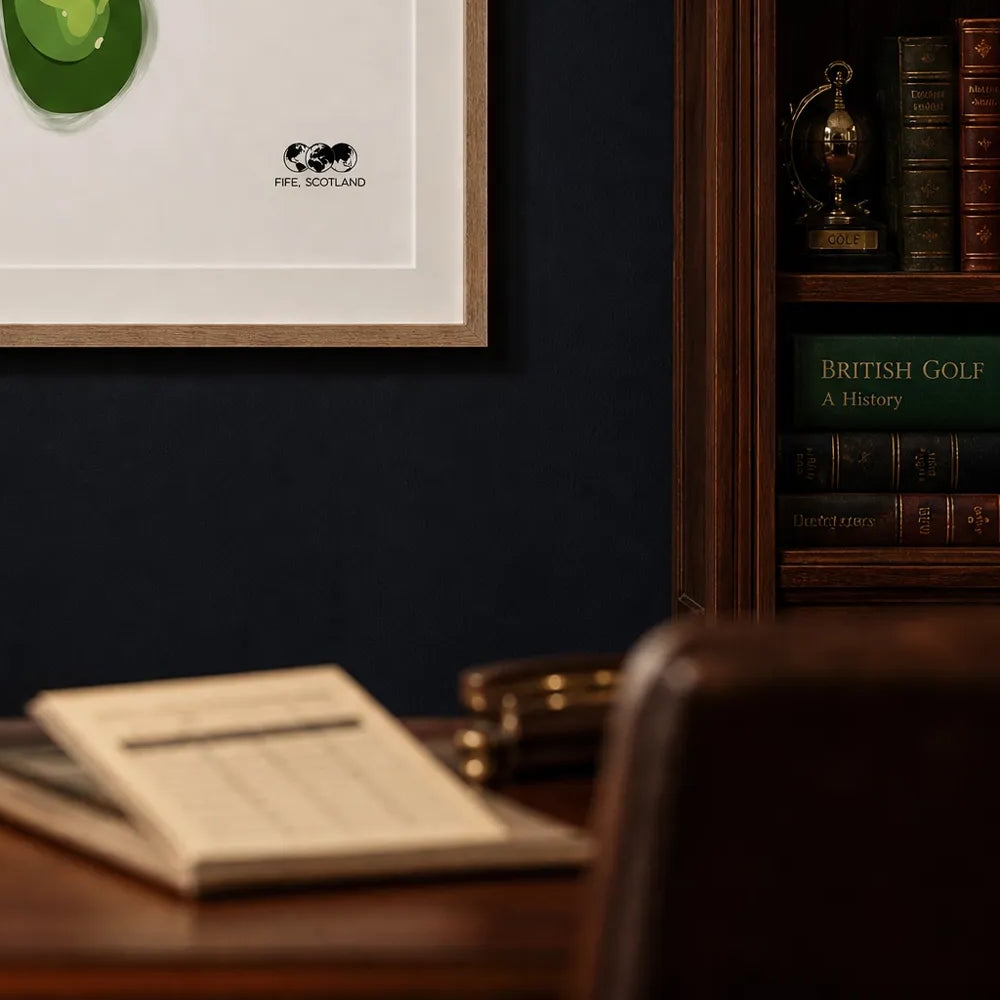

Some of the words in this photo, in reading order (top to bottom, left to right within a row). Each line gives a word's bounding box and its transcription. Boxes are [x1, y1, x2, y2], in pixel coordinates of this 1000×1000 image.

[274, 177, 301, 188] FIFE,
[305, 177, 366, 188] SCOTLAND
[821, 391, 835, 406] A
[842, 391, 903, 410] History
